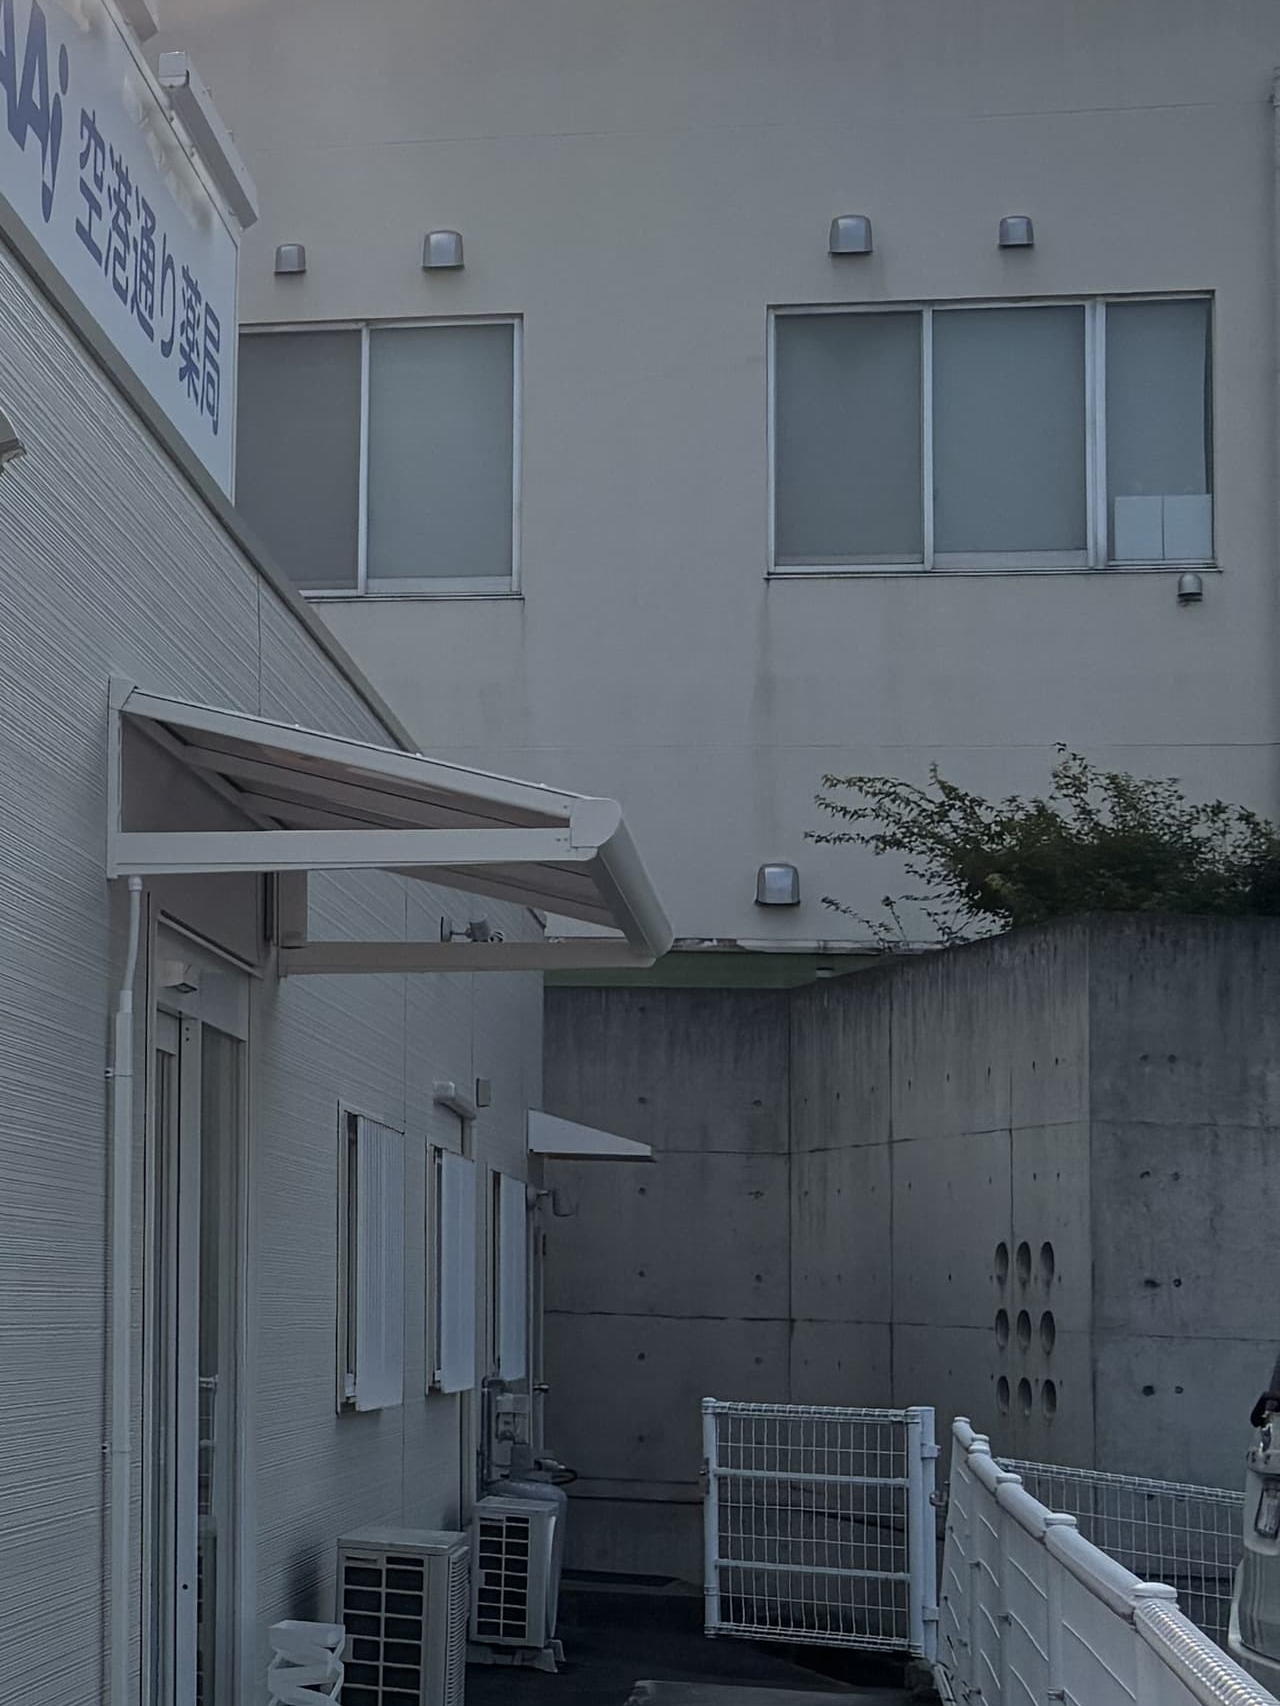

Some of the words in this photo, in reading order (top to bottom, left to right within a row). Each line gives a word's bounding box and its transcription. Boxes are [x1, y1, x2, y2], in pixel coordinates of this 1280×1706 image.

[75, 106, 220, 436] 空港通り薬局
